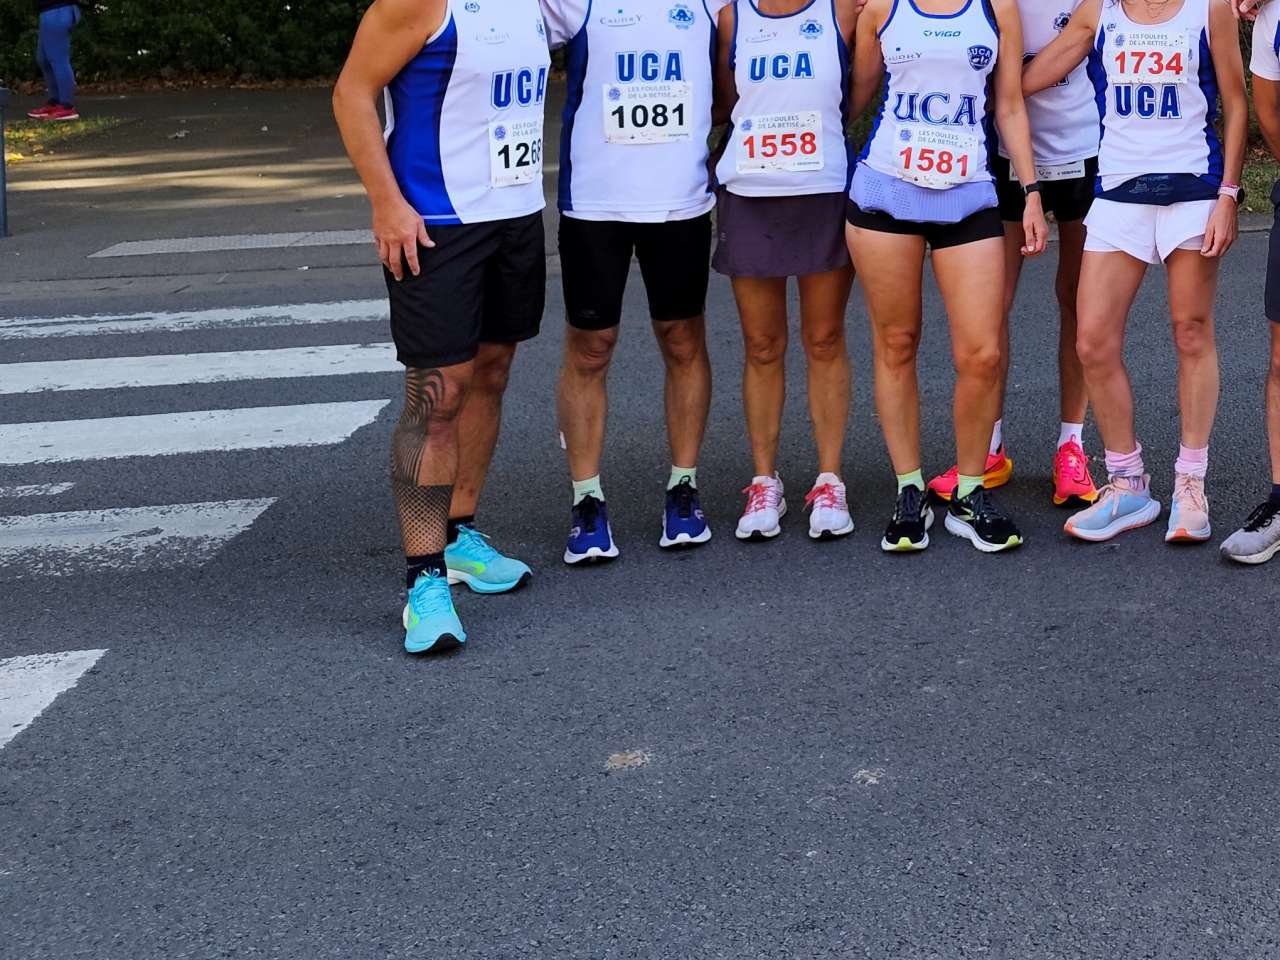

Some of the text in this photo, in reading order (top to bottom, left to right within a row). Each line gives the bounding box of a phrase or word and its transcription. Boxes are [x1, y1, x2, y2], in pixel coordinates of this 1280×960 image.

[616, 50, 684, 84] UCA
[748, 51, 814, 83] UCA
[971, 47, 992, 58] UCA
[1114, 51, 1183, 75] 1734
[490, 65, 545, 111] UCA
[1113, 83, 1182, 119] UCA
[611, 103, 684, 129] 1081
[893, 92, 978, 127] UCA
[743, 132, 817, 159] 1558
[899, 146, 968, 177] 1581
